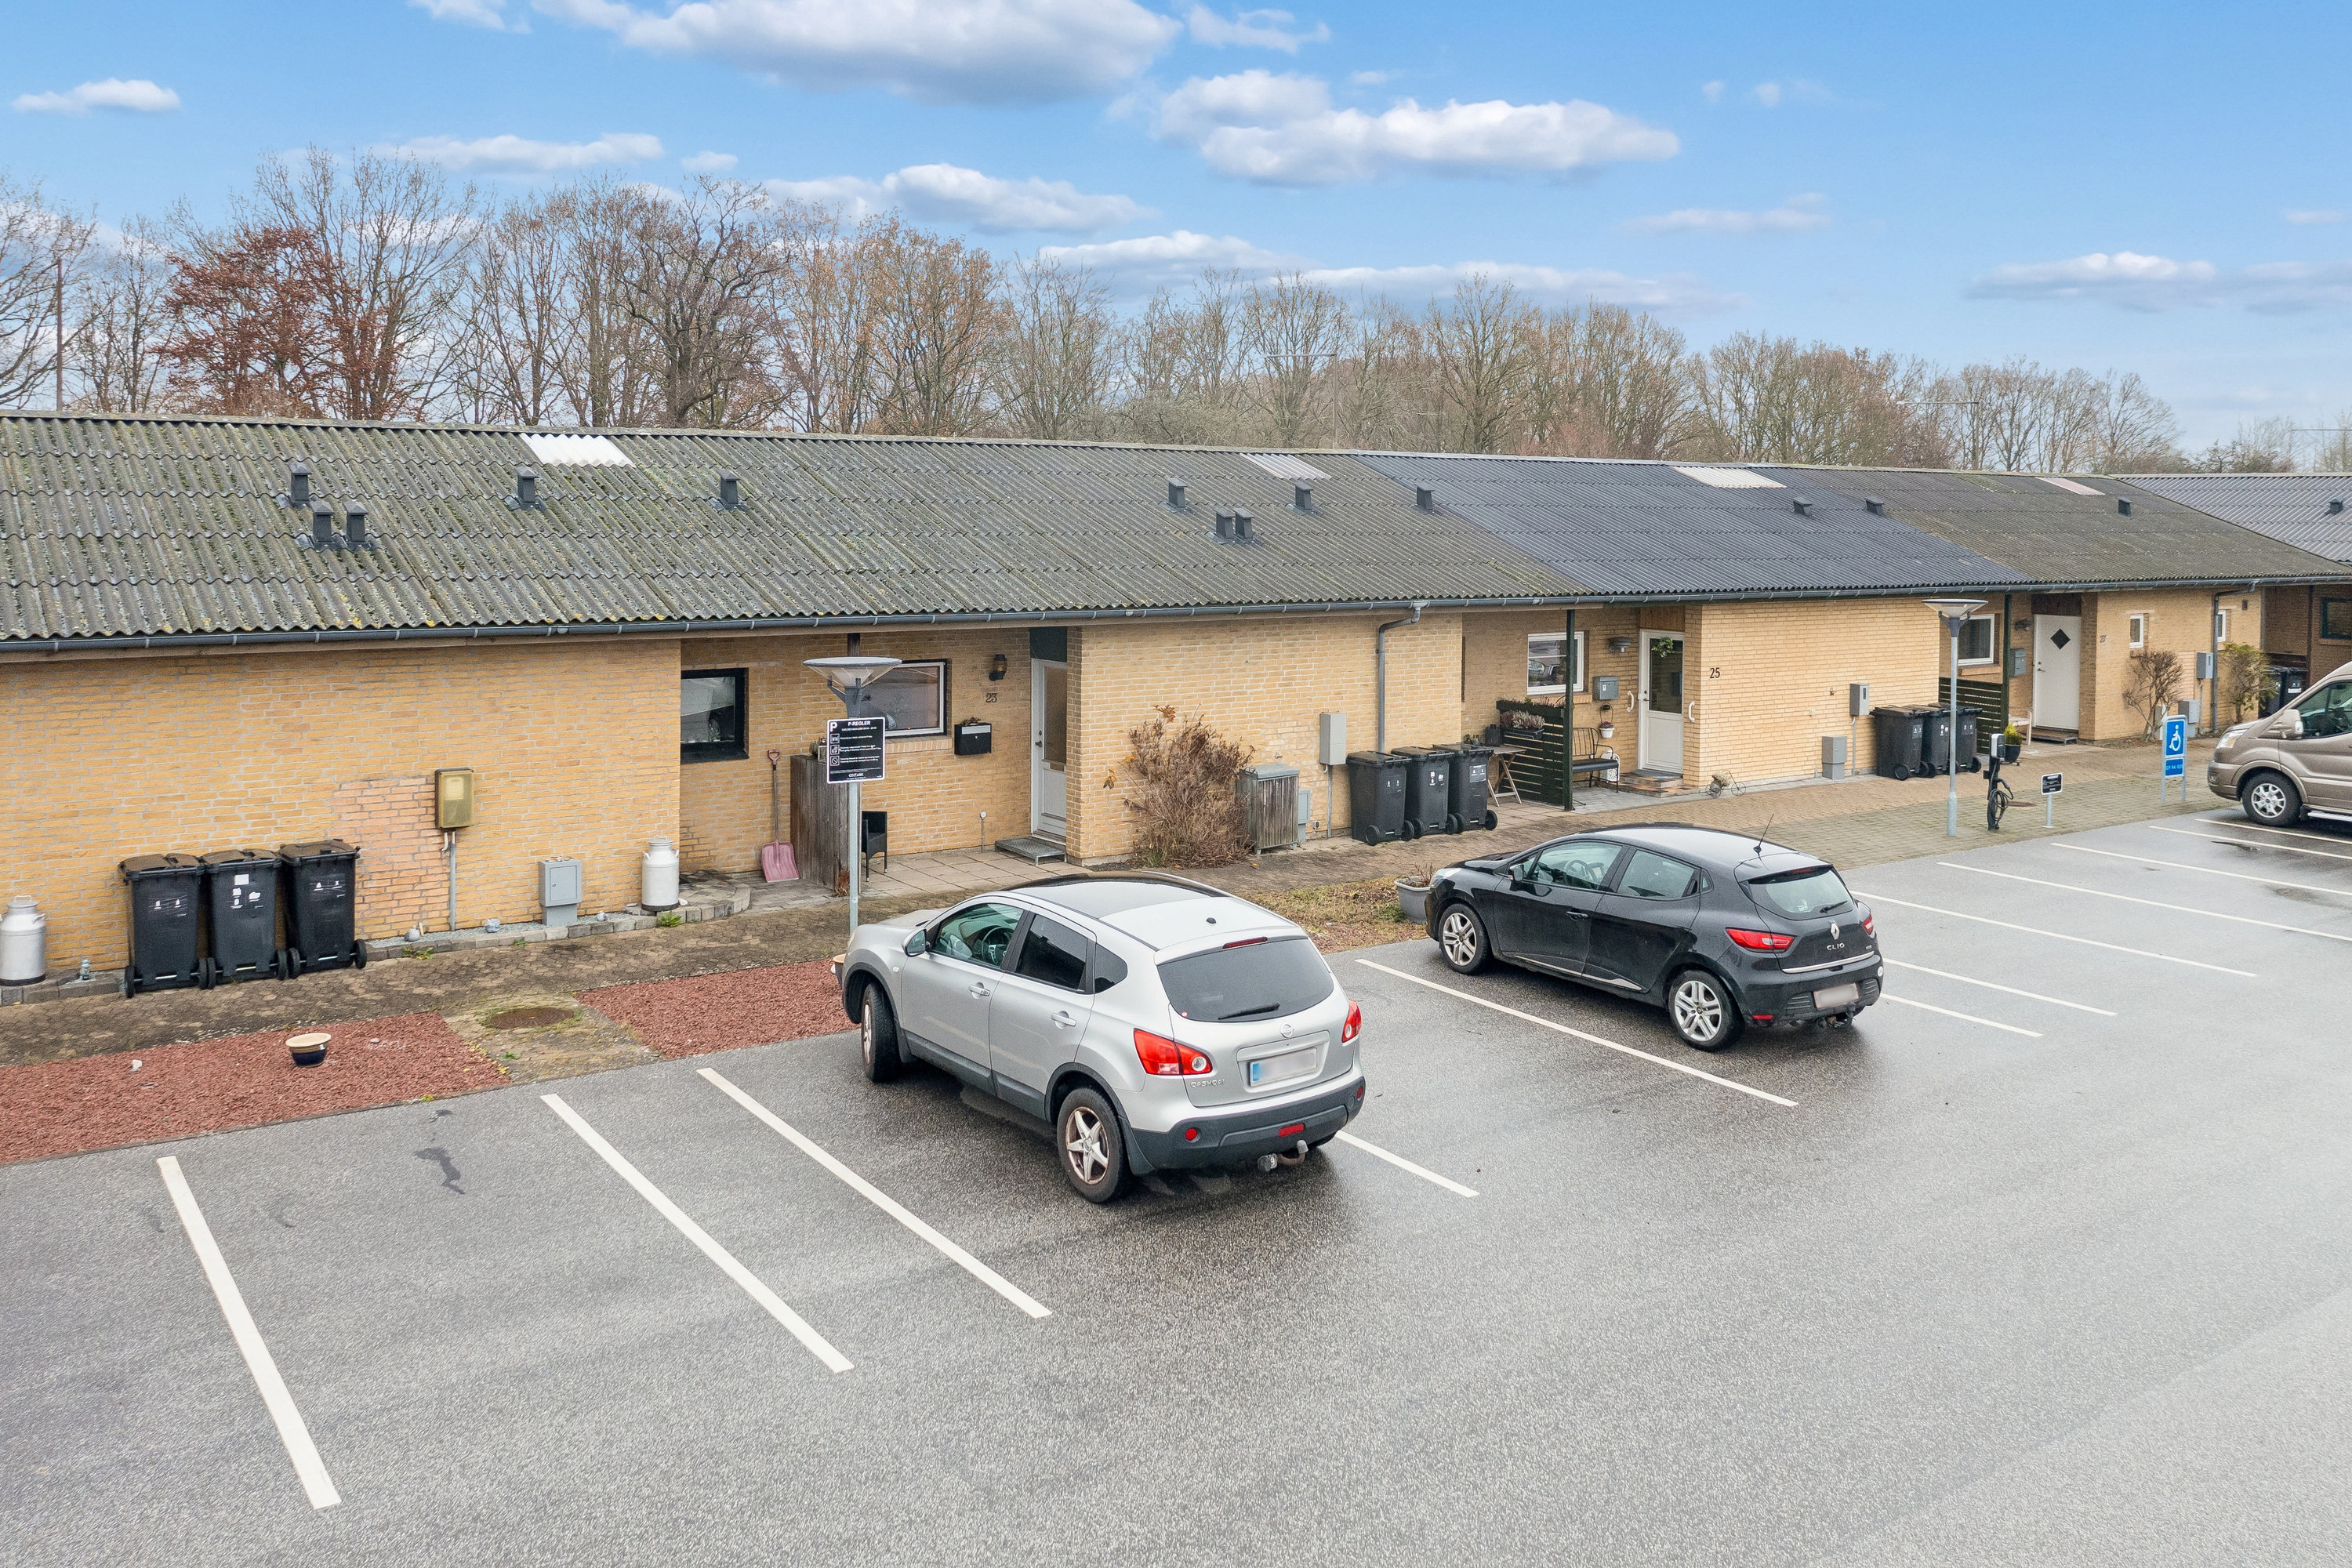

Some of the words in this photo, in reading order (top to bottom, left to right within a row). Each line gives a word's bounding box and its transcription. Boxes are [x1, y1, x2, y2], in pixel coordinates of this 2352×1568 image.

[1710, 667, 1721, 678] 25
[985, 692, 998, 703] 23
[830, 721, 838, 732] P
[1190, 1078, 1225, 1089] QASHQAI
